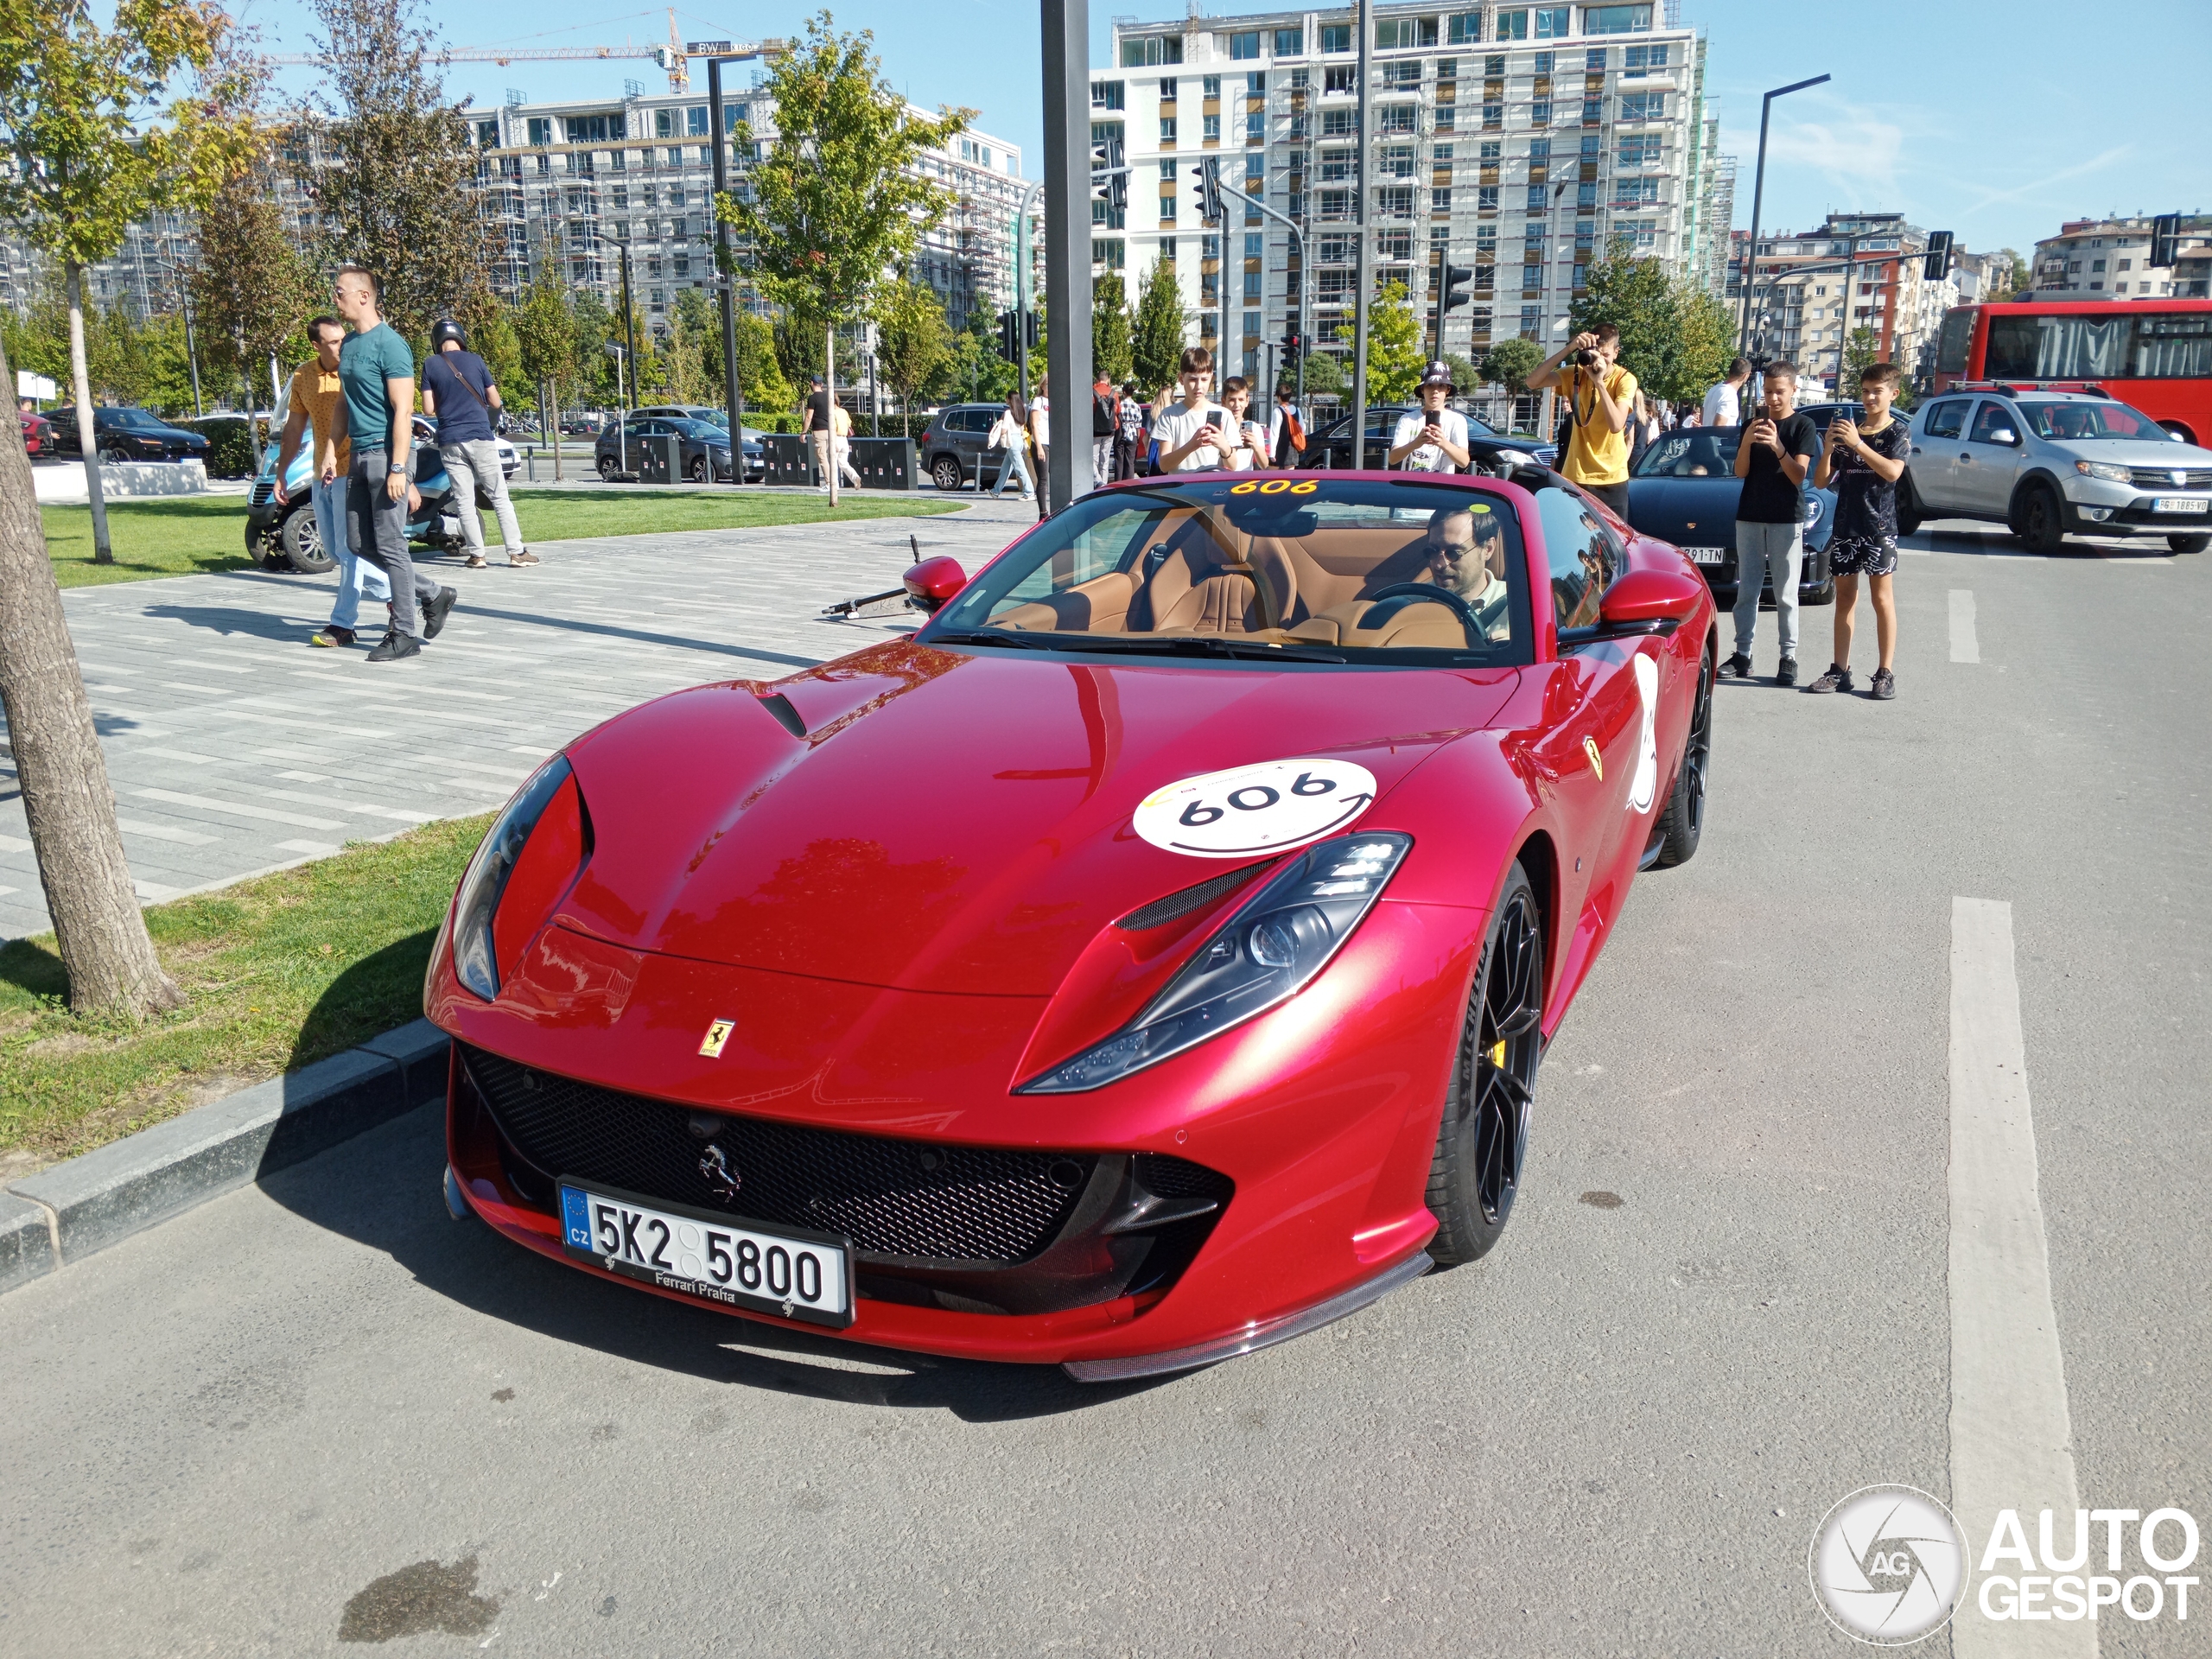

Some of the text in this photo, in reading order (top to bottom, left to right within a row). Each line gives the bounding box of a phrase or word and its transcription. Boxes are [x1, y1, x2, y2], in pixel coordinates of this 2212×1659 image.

[698, 42, 719, 54] BW
[1230, 480, 1320, 494] 606
[1179, 771, 1338, 827] 606
[1461, 944, 1489, 1081] MICHELIN
[570, 1227, 589, 1245] CZ
[595, 1203, 822, 1303] 5K2 5800
[655, 1270, 735, 1304] Ferrari Praha
